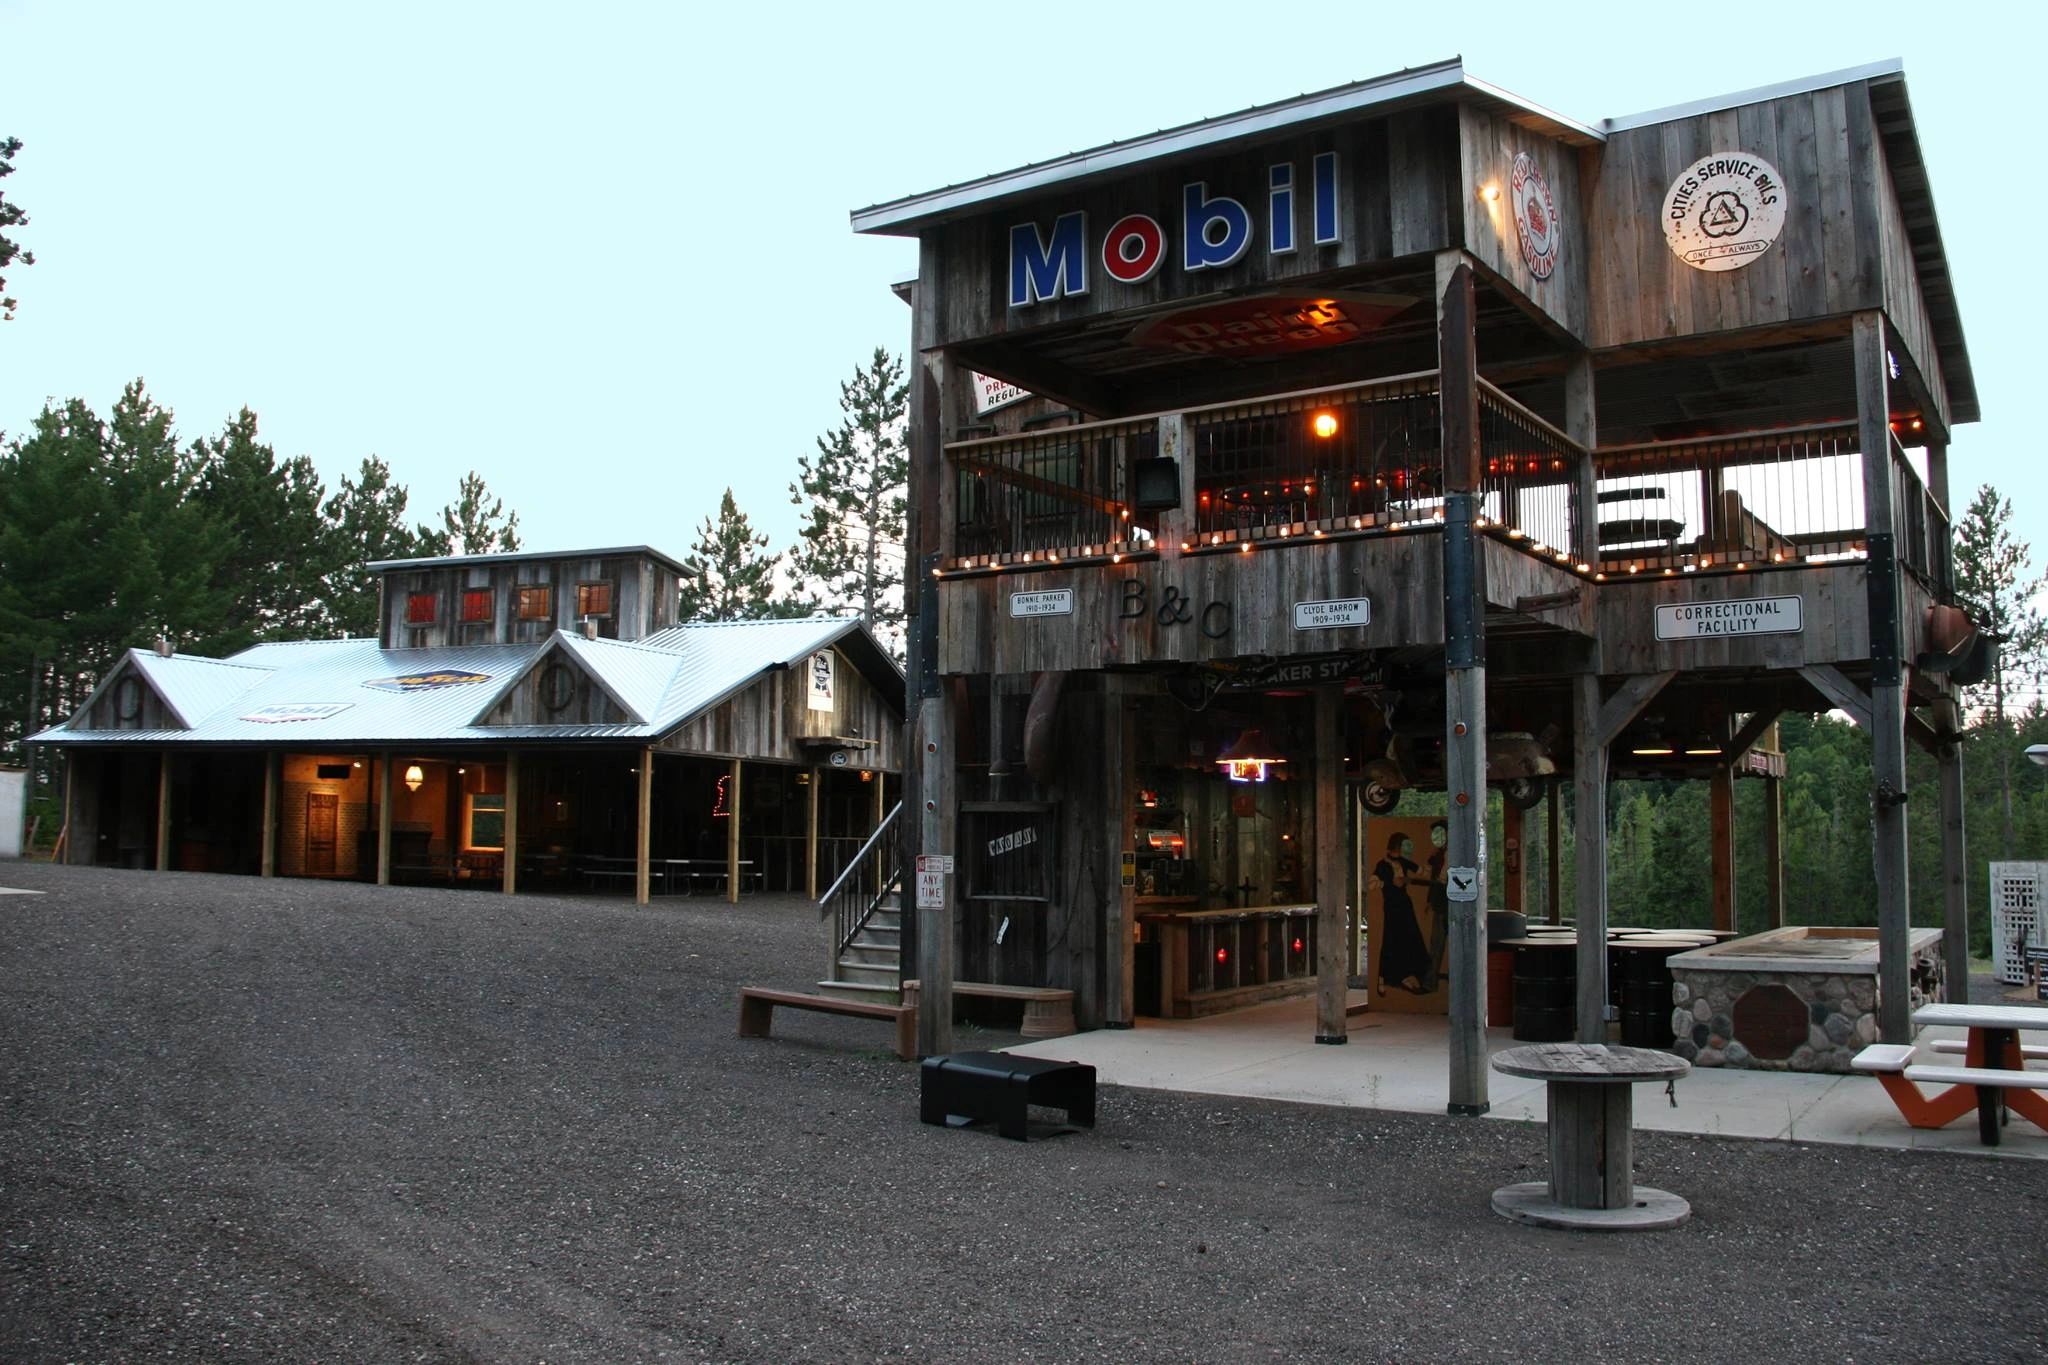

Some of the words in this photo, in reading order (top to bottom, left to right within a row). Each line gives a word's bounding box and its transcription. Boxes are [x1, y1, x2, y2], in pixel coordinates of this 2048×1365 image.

[1512, 160, 1527, 193] RED
[1671, 177, 1699, 220] CITIES
[1698, 159, 1758, 182] SERVICE
[1009, 151, 1342, 308] Mobil
[1518, 217, 1557, 276] GASOLINE
[1693, 249, 1713, 260] ONCE
[1729, 242, 1761, 254] ALWAYS
[1175, 298, 1348, 339] Dairy
[1173, 321, 1360, 354] Queen
[985, 381, 1008, 395] PRE
[988, 387, 1024, 406] REGUL
[1017, 595, 1039, 605] BONNIE
[1043, 593, 1065, 603] PARKER
[1026, 603, 1056, 613] 1910-1934
[1303, 604, 1325, 615] CLYDE
[1329, 603, 1359, 613] BARROW
[1675, 602, 1781, 621] CORRECTIONAL
[1312, 614, 1350, 625] 1909-1934
[1698, 618, 1758, 634] FACILITY
[1266, 665, 1313, 683] AKER
[923, 875, 938, 885] ANY
[921, 887, 941, 898] TIME
